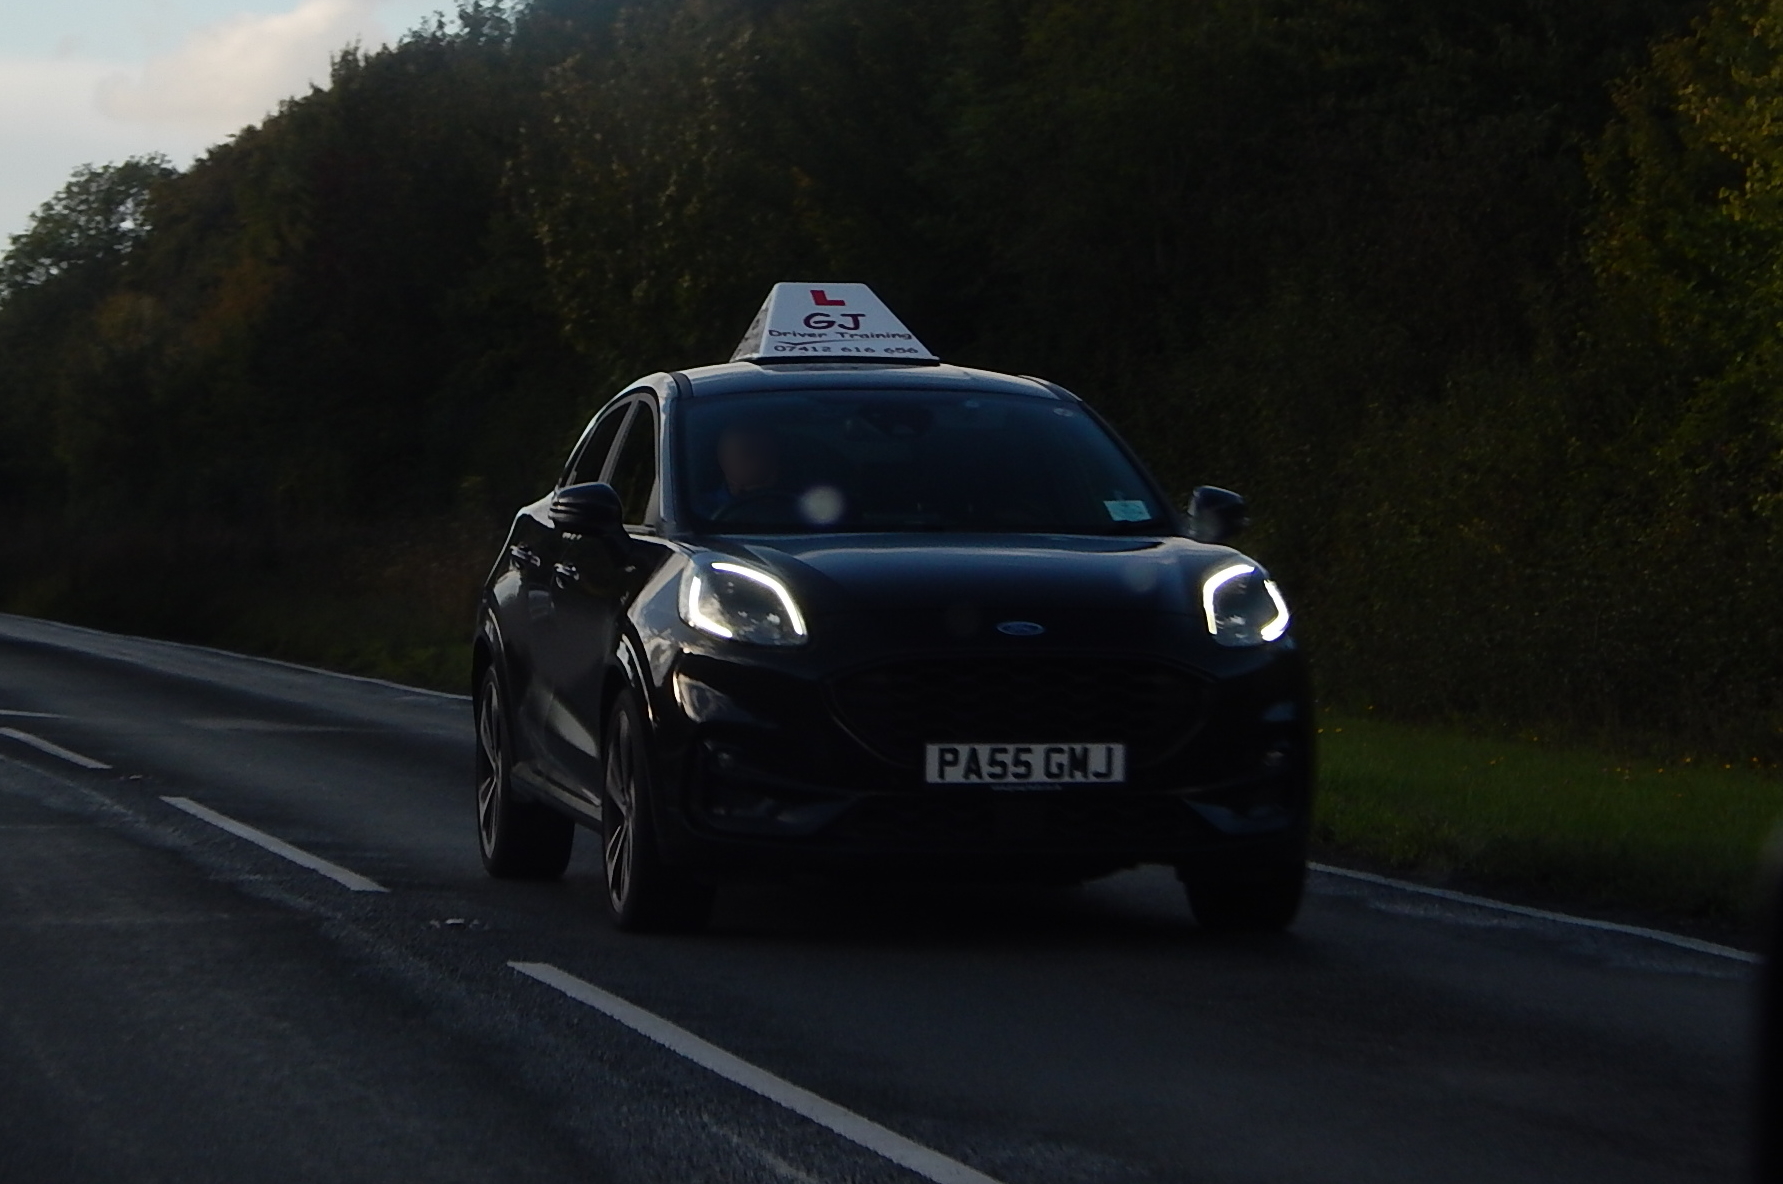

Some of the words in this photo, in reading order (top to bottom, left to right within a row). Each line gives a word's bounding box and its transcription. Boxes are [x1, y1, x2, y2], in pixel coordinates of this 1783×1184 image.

[809, 289, 846, 306] L
[803, 312, 866, 331] GJ
[768, 329, 828, 338] Driver
[835, 331, 913, 341] Training
[1043, 746, 1114, 780] GMJ
